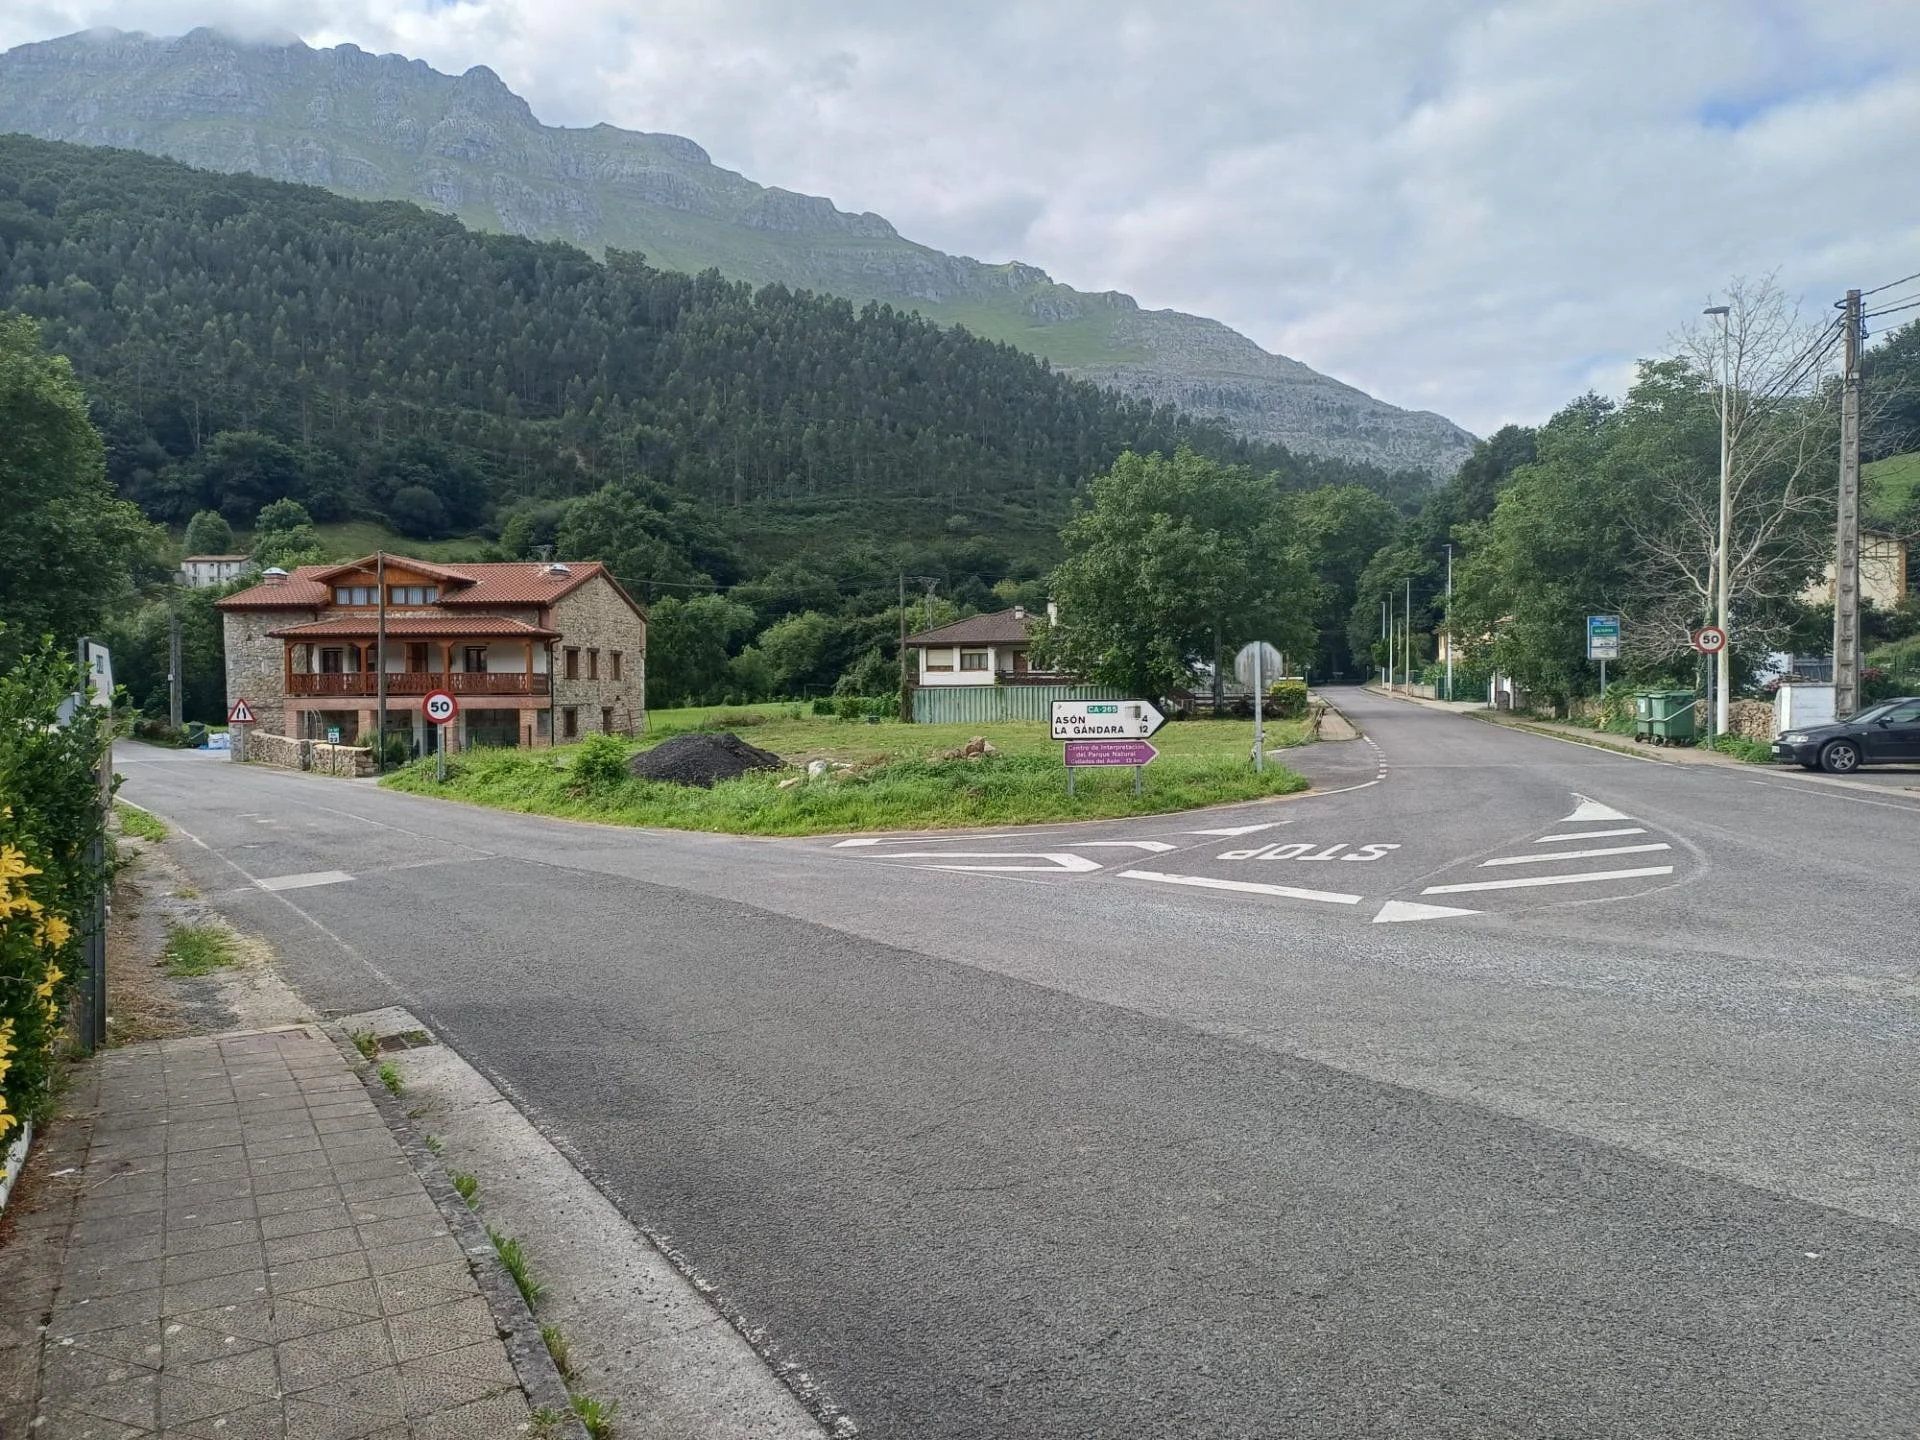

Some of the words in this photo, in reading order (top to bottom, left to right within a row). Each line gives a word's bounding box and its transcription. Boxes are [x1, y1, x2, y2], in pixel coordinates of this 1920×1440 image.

[1703, 635, 1720, 644] 50
[430, 701, 450, 712] 50
[1055, 714, 1086, 724] ASÓN
[1054, 726, 1068, 735] LA
[1073, 724, 1125, 735] GÁNDARA
[1139, 725, 1149, 733] 12
[1216, 843, 1402, 861] STOP
